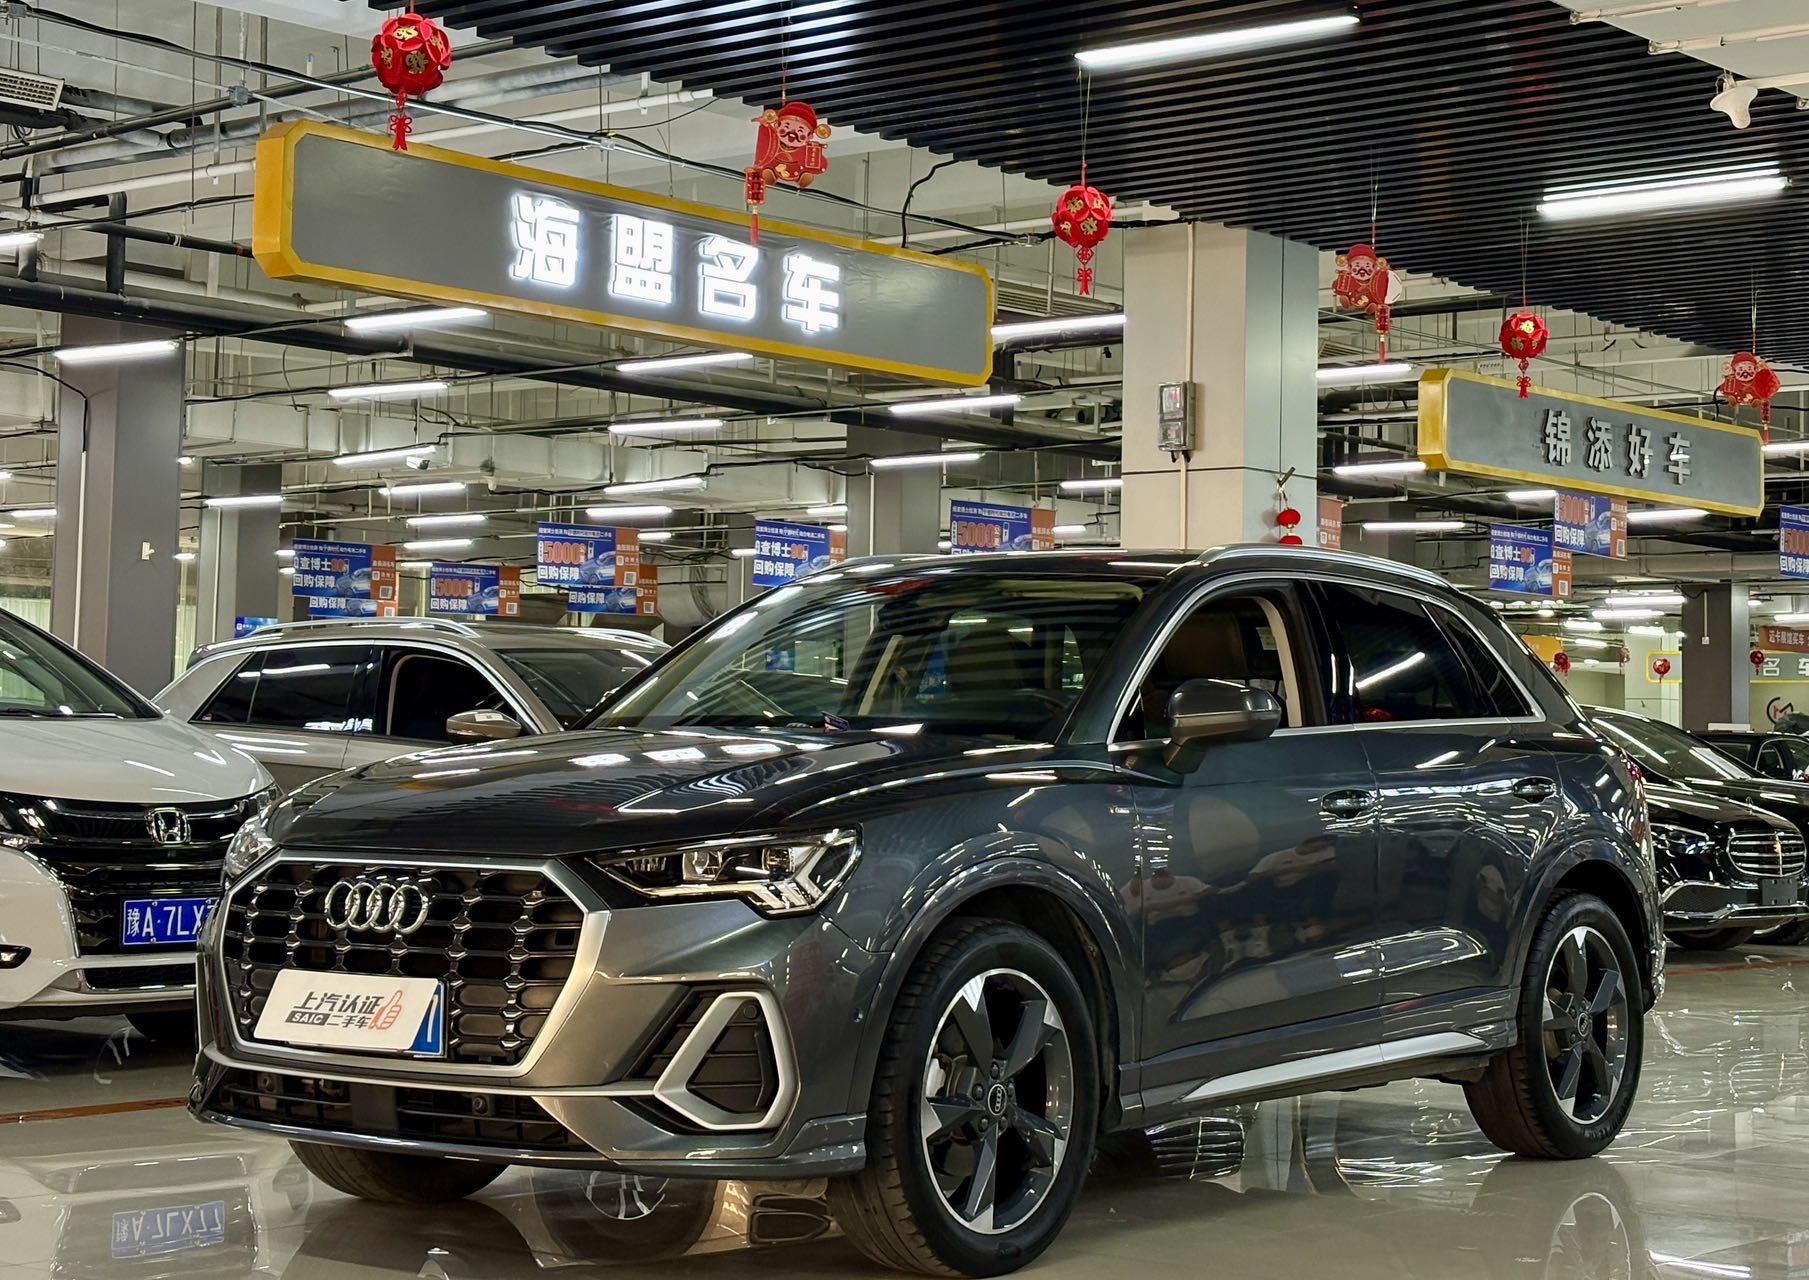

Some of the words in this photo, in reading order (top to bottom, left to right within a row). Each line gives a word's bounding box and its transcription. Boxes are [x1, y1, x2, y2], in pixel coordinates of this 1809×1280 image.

[510, 191, 841, 332] 海盟名车
[1543, 408, 1691, 484] 锦添好车
[761, 541, 791, 558] 查博士
[300, 557, 331, 571] 查博士
[753, 559, 795, 577] 回购保障
[293, 573, 335, 588] 回购保障
[537, 566, 579, 580] 回购保障
[1490, 564, 1524, 582] 回购保障
[430, 598, 467, 611] 回购保障
[569, 591, 605, 604] 回购保障
[293, 991, 384, 1014] 上汽认证
[291, 1012, 324, 1024] SAIC
[326, 1014, 371, 1028] 二手车
